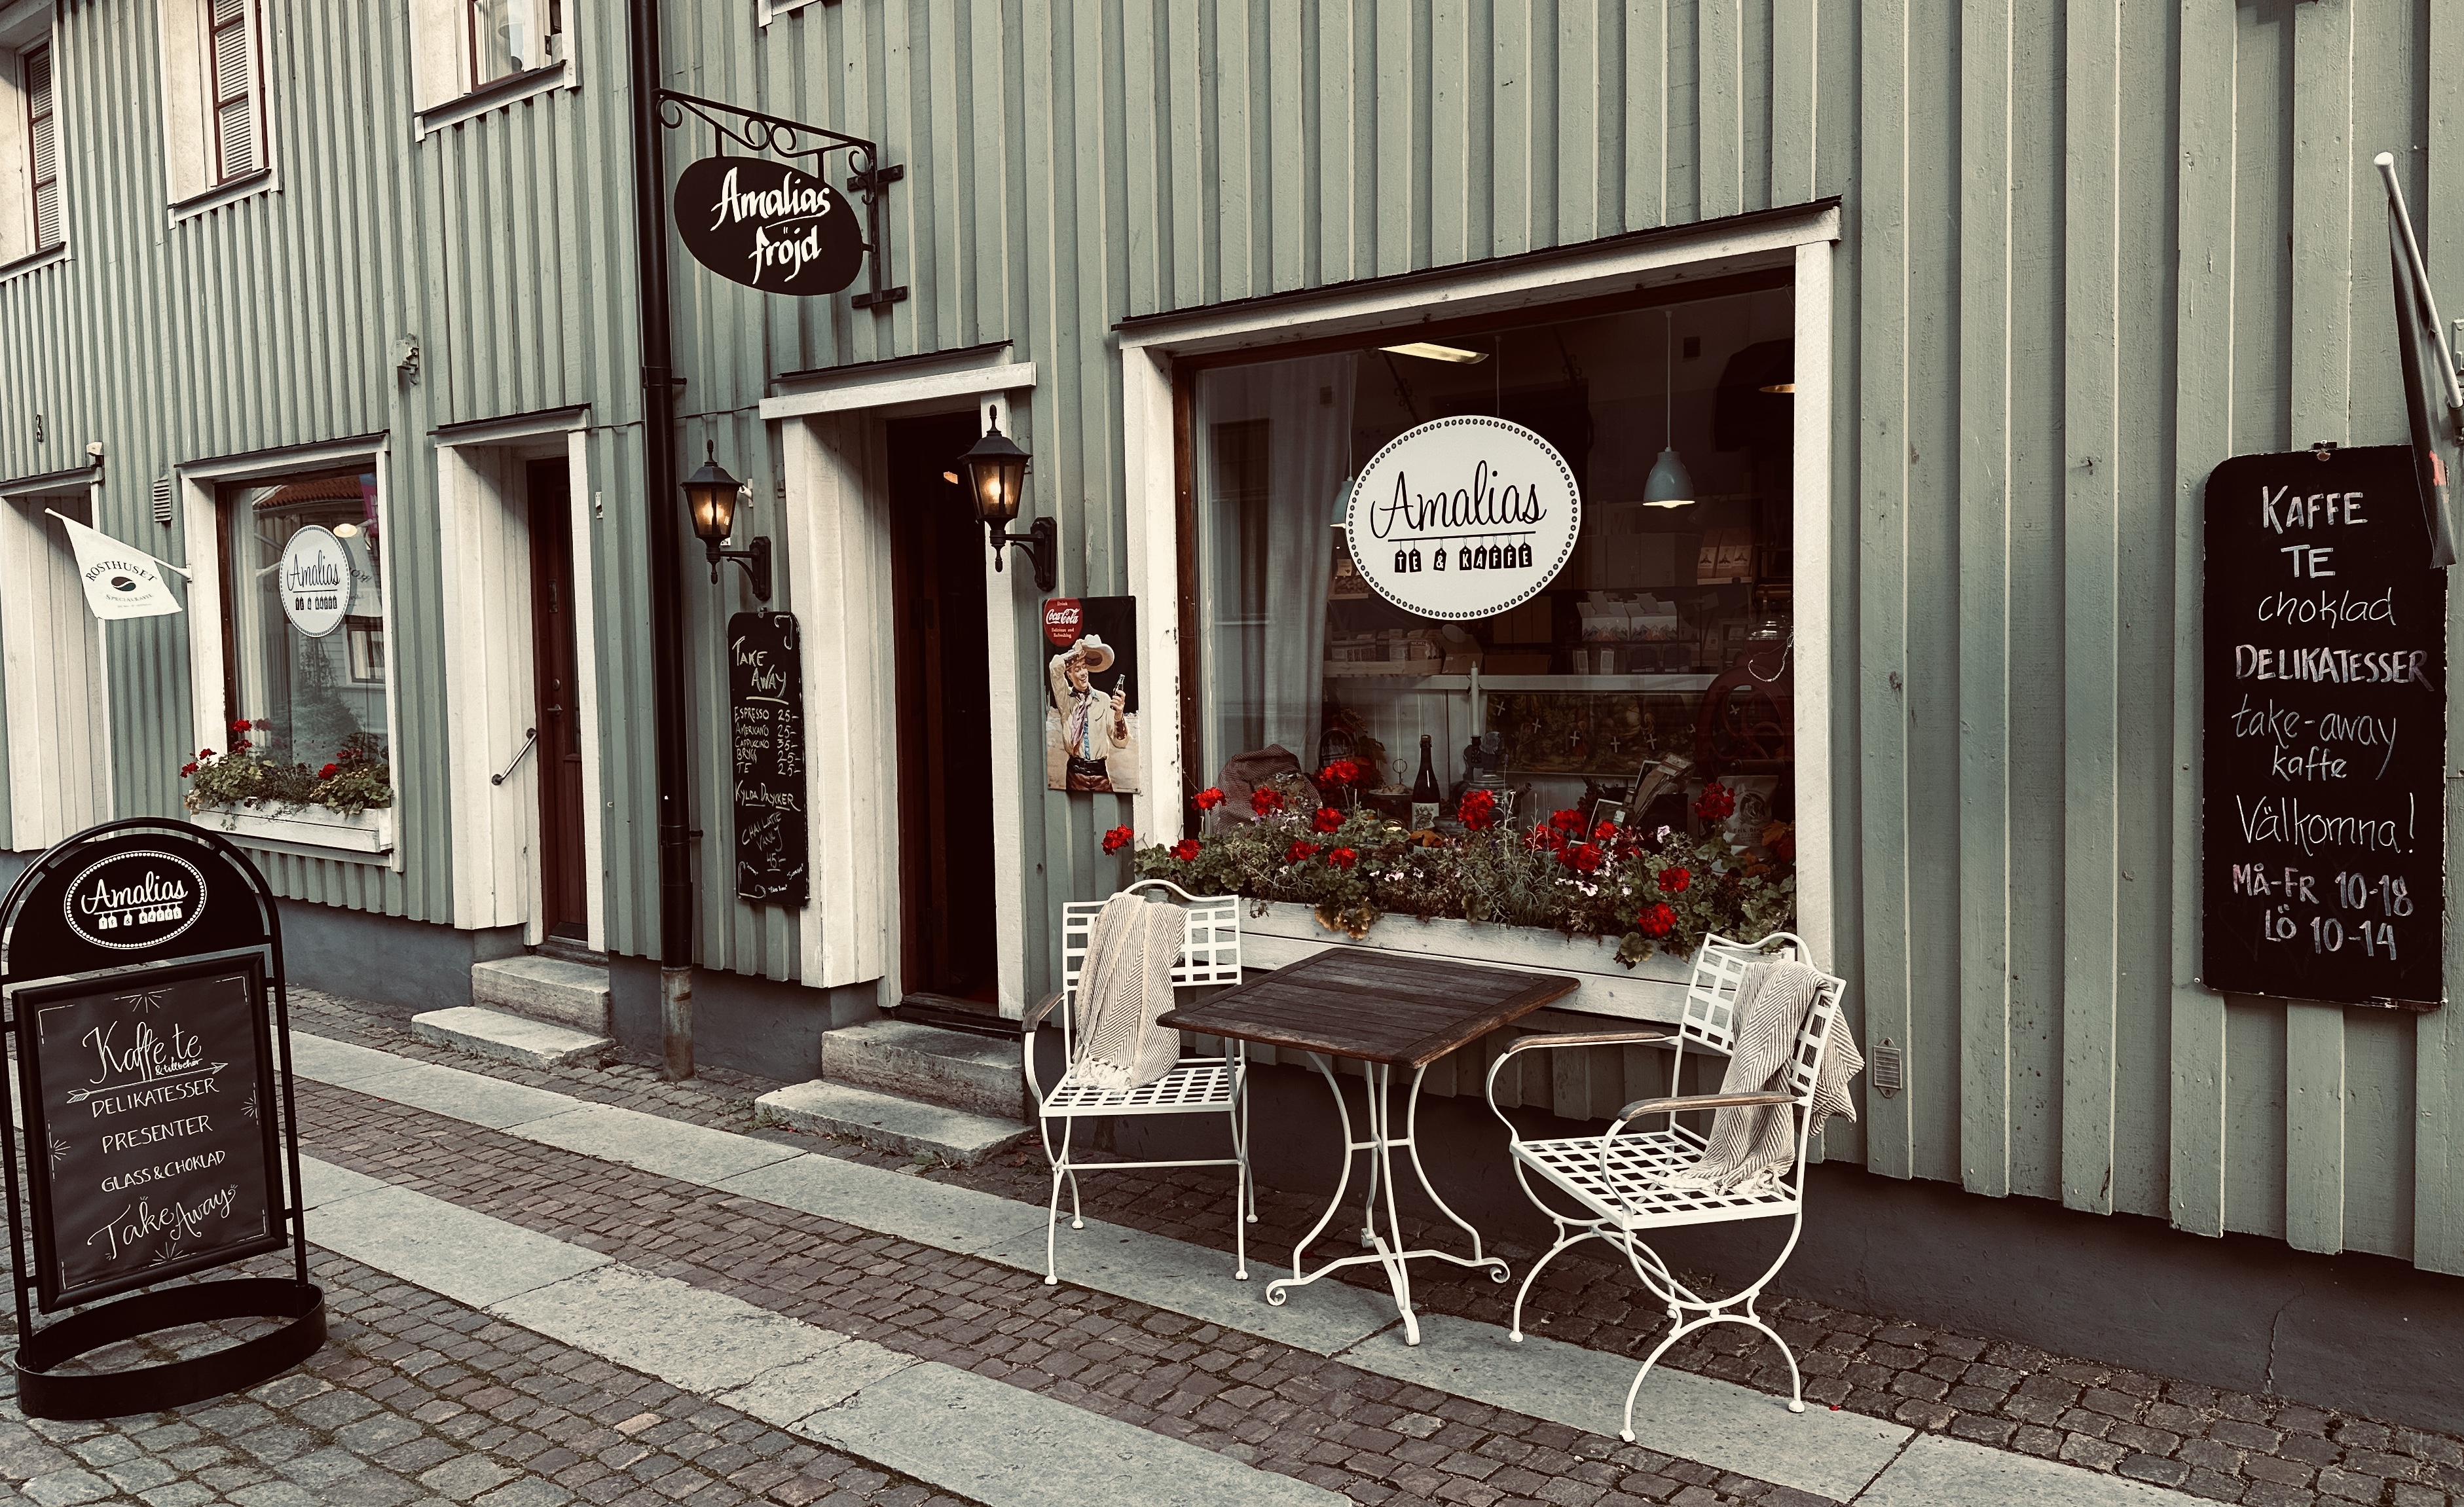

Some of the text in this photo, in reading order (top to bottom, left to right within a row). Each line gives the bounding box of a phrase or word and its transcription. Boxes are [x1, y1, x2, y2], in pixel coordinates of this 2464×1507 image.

[710, 166, 831, 231] Amalias
[748, 225, 822, 284] fröjd
[1370, 460, 1547, 538] Amalias
[2262, 485, 2368, 534] KAFFE
[287, 549, 340, 590] Amalias
[1397, 551, 1529, 570] TE & KAFFE
[2281, 544, 2336, 578] TE
[2258, 587, 2396, 629] choklad
[732, 636, 767, 666] TAKE
[2235, 644, 2435, 691] DELIKATESSER
[752, 664, 786, 699] AWAY
[734, 706, 769, 723] ESPRESSO
[735, 722, 769, 737] AMERICANO
[737, 748, 757, 764] BRYGG
[2232, 693, 2397, 780] take-away
[737, 762, 752, 774] TE
[2271, 746, 2347, 782] kaffe
[742, 811, 781, 845] CHAI LATTE
[81, 871, 188, 914] Amalias
[2232, 862, 2414, 917] MÅ-FR 10-18
[2264, 903, 2397, 960] LÖ 10-14
[172, 1023, 202, 1059] te
[155, 1064, 165, 1076] &
[92, 1078, 220, 1118] DELIKATESSER
[102, 1115, 213, 1153] PRESENTER
[101, 1150, 225, 1192] GLASS & CHOKLAD
[87, 1188, 236, 1260] Take Away
